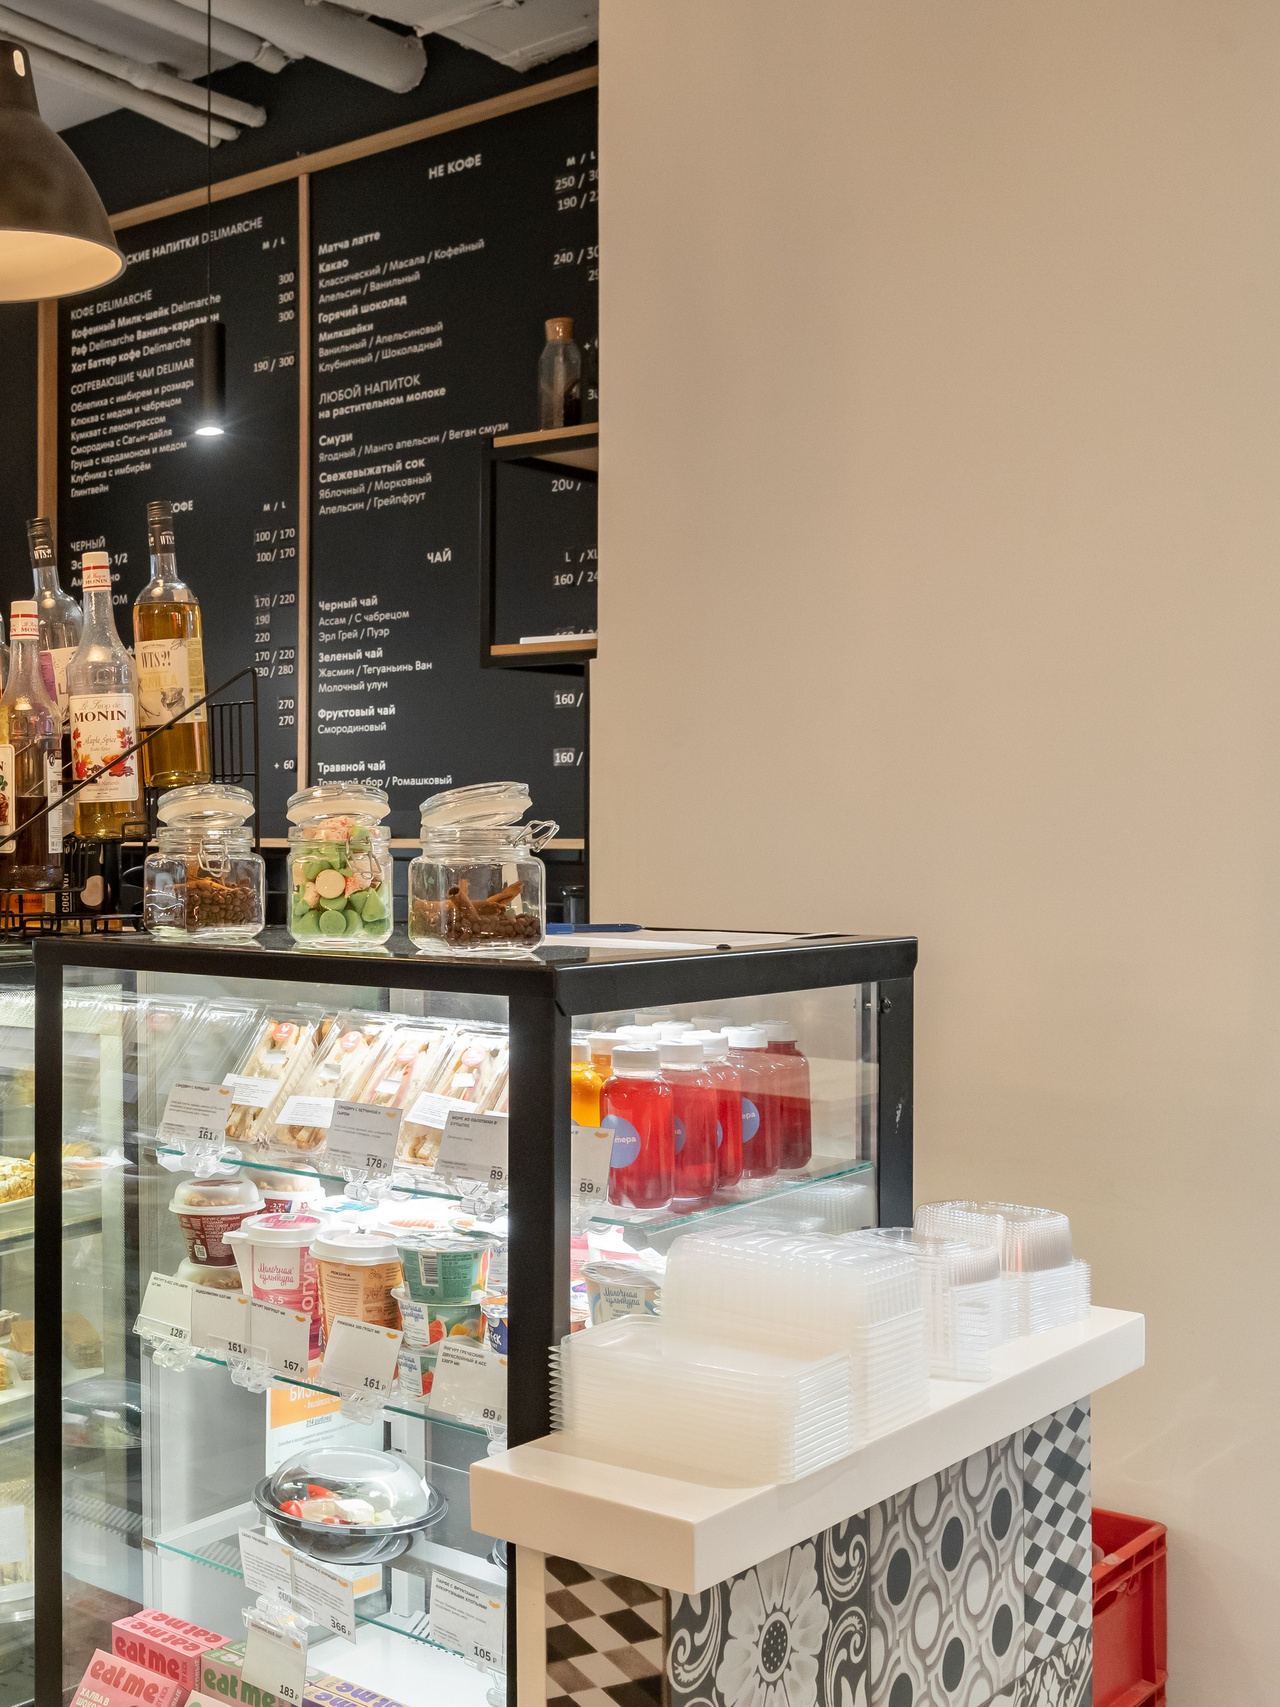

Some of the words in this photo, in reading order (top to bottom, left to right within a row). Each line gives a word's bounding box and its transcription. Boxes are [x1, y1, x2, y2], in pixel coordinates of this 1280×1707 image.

[429, 166, 444, 179] НЕ
[448, 154, 481, 175] КОФЕ
[555, 176, 575, 191] 250
[557, 197, 577, 211] 190
[153, 236, 199, 258] НАПИТКИ
[319, 242, 349, 255] Матча
[352, 231, 380, 247] латте
[319, 266, 380, 289] Классический
[389, 255, 425, 272] Масала
[434, 239, 485, 260] Кофейный
[319, 259, 349, 273] Какао
[553, 253, 573, 266] 240
[279, 273, 294, 285] 300
[319, 287, 361, 304] Апельсин
[370, 271, 420, 292] Ванильный
[279, 291, 294, 303] 300
[71, 305, 94, 320] КОФЕ
[97, 290, 152, 313] DELIMARCHE
[118, 306, 169, 328] Милк-шейк
[171, 294, 221, 314] Delimarche
[318, 305, 358, 324] Горячий
[361, 295, 407, 315] шоколад
[279, 310, 294, 323] 300
[319, 323, 373, 342] Милкшейки
[319, 339, 367, 357] Ванильный
[376, 322, 443, 345] Апельсиновый
[71, 345, 87, 356] Раф
[89, 332, 134, 351] Delimarche
[71, 362, 86, 373] Хот
[88, 355, 116, 371] Баттер
[119, 349, 141, 364] кофе
[143, 337, 191, 357] Delimarche
[319, 353, 373, 374] Клубничный
[382, 338, 442, 359] Шоколадный
[253, 360, 268, 372] 190
[279, 355, 294, 368] 300
[71, 374, 134, 395] СОГРЕВАЮЩИЕ
[157, 358, 194, 377] DELIMAR
[319, 384, 361, 405] ЛЮБОЙ
[364, 374, 420, 395] НАПИТОК
[71, 397, 108, 413] Облепиха
[116, 386, 152, 404] имбирем
[333, 395, 404, 419] растительном
[406, 386, 446, 402] молоке
[71, 411, 99, 427] Клюква
[107, 406, 133, 420] медом
[142, 397, 182, 414] чабрецом
[71, 427, 101, 442] Кумкват
[109, 414, 165, 435] лемонграссом
[71, 439, 114, 456] Смородина
[319, 433, 353, 447] Смузи
[319, 448, 356, 463] Ягодный
[364, 439, 393, 455] Манго
[395, 434, 440, 451] апельсин
[449, 428, 476, 441] Веган
[479, 422, 508, 437] смузи
[71, 457, 93, 471] Груша
[101, 448, 150, 465] кардамоном
[159, 440, 187, 453] медом
[71, 468, 106, 484] Клубника
[319, 460, 402, 484] Свежевыжатый
[405, 457, 425, 469] сок
[71, 483, 109, 498] Глинтвейн
[319, 484, 365, 500] Яблочный
[374, 473, 432, 491] Морковный
[319, 501, 364, 515] Апельсин
[374, 491, 425, 510] Грейпфрут
[255, 531, 270, 542] 100
[280, 528, 295, 540] 170
[71, 536, 105, 551] ЧЕРНЫЙ
[256, 552, 271, 562] 100
[280, 548, 295, 559] 170
[427, 548, 451, 563] ЧАЙ
[554, 574, 573, 586] 160
[255, 596, 270, 608] 170
[280, 593, 295, 604] 220
[319, 597, 357, 612] Черный
[360, 595, 378, 607] чай
[255, 614, 270, 625] 190
[319, 615, 346, 627] Ассам
[364, 610, 409, 625] чабрецом
[255, 632, 270, 643] 220
[319, 631, 336, 642] Эрл
[339, 628, 358, 641] Грей
[367, 627, 389, 639] Пуэр
[141, 651, 171, 668] WTS?!
[255, 651, 270, 662] 170
[280, 649, 294, 660] 220
[318, 649, 362, 663] Зеленый
[364, 647, 383, 659] чай
[319, 667, 354, 678] Жасмин
[363, 663, 413, 676] Тегуаньинь
[415, 661, 432, 671] Ван
[318, 681, 364, 693] Молочный
[367, 680, 388, 691] улун
[279, 699, 294, 710] 270
[556, 693, 574, 705] 160
[74, 710, 127, 722] MONIN
[279, 714, 294, 726] 270
[318, 706, 375, 721] Фруктовый
[377, 704, 395, 716] чай
[318, 722, 386, 735] Смородиновый
[555, 752, 573, 764] 160
[318, 761, 365, 775] Травяной
[367, 760, 385, 772] чай
[361, 778, 383, 788] сбор
[393, 775, 452, 786] Ромашковый
[199, 1130, 213, 1141] 161
[365, 1157, 382, 1168] 178
[490, 1169, 502, 1181] 89
[580, 1182, 594, 1192] 89
[258, 1262, 292, 1274] Молочная
[260, 1273, 294, 1286] культура
[170, 1328, 182, 1338] 128
[228, 1342, 242, 1353] 161
[284, 1360, 298, 1371] 167
[363, 1377, 380, 1390] 161
[482, 1408, 496, 1420] 89
[330, 1618, 346, 1634] 366
[115, 1636, 146, 1665] eat
[147, 1648, 180, 1681] me
[474, 1646, 491, 1661] 105
[90, 1659, 126, 1688] eat
[122, 1671, 159, 1704] me
[279, 1684, 294, 1699] 183
